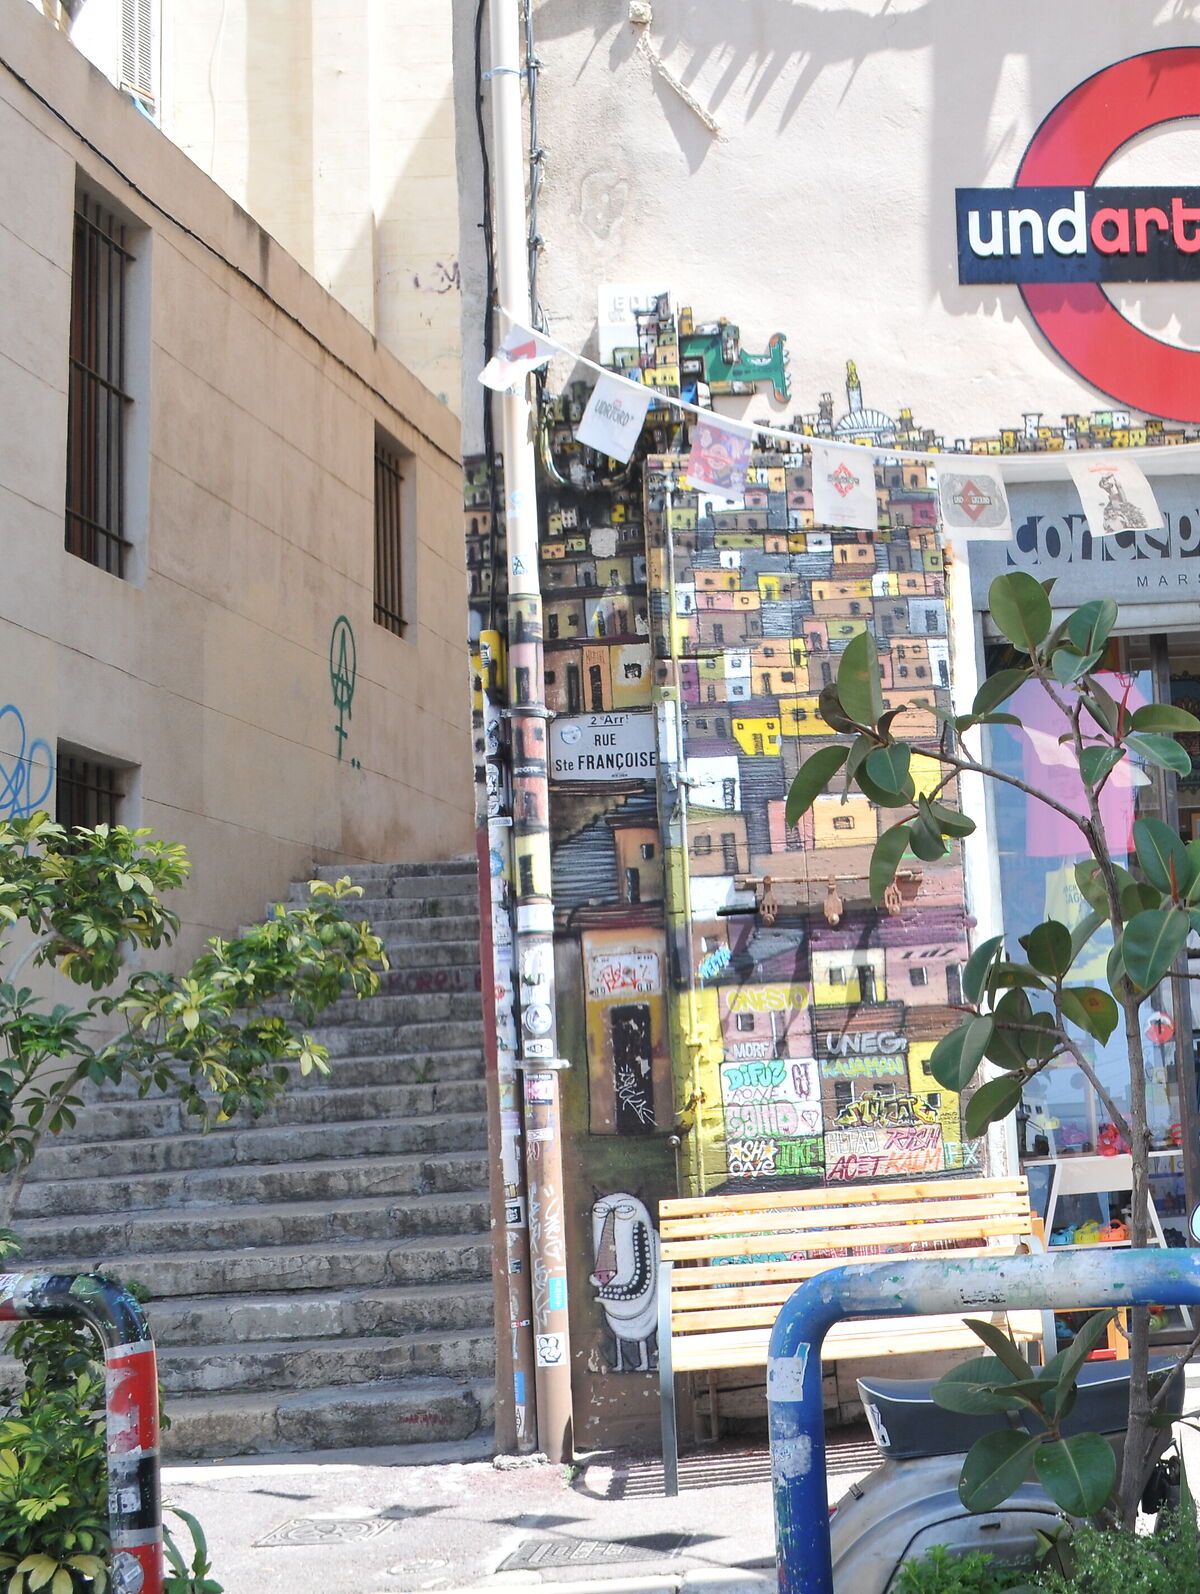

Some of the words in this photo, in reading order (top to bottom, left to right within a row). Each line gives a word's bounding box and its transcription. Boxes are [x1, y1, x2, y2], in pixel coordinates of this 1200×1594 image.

[594, 733, 616, 746] RUE
[555, 759, 574, 772] Ste
[578, 751, 656, 770] FRANÇOISE
